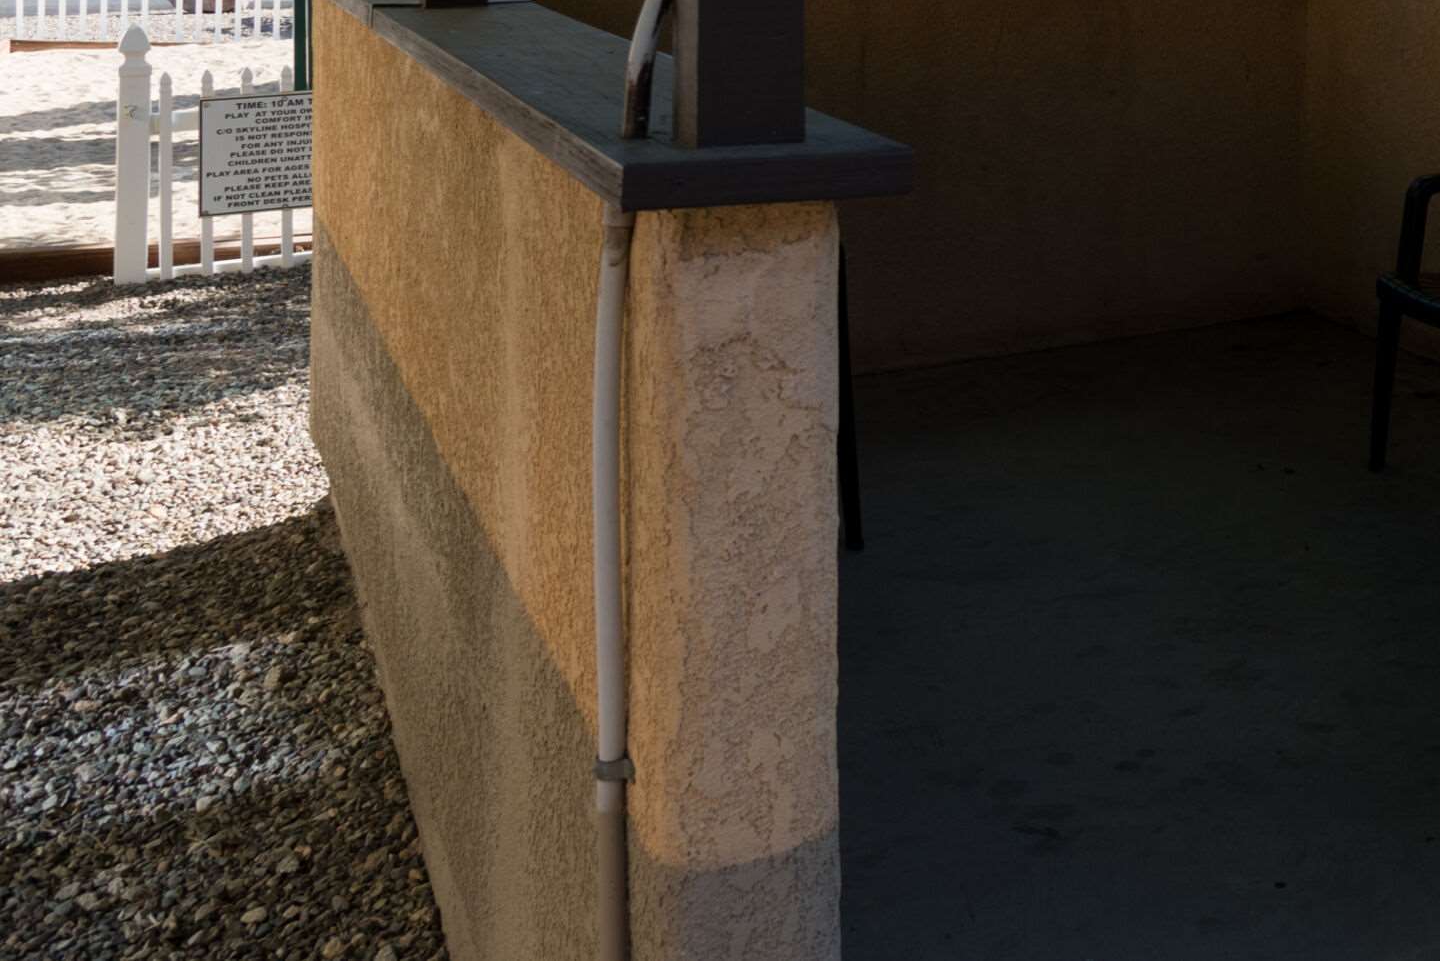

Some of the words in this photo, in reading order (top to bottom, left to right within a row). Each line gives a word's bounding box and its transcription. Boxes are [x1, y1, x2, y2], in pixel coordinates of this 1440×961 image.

[236, 101, 267, 110] TIME:
[255, 116, 302, 124] COMFORT
[236, 125, 278, 133] SKYLINE
[230, 149, 267, 158] PLEASE
[228, 156, 277, 166] CHILDREN
[224, 184, 261, 192] PLEASE
[249, 190, 280, 198] CLEAN
